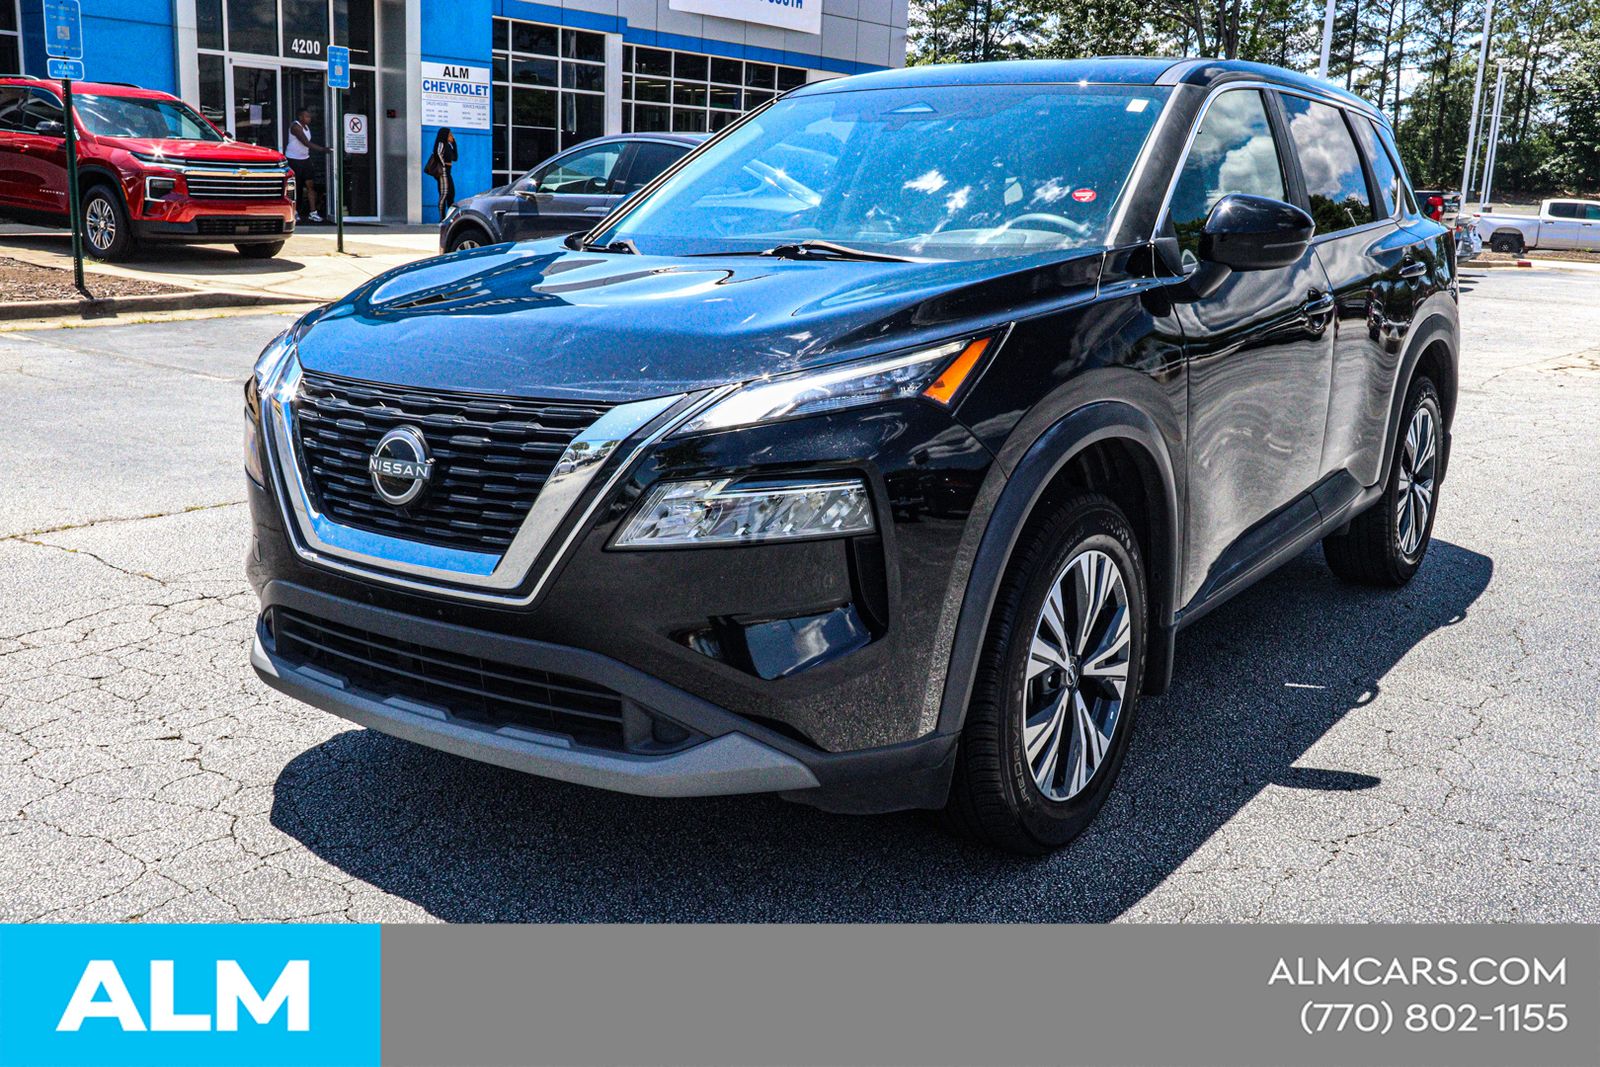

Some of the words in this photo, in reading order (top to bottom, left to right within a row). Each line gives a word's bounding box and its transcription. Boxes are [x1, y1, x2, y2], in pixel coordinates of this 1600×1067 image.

[291, 38, 321, 55] 4200
[443, 65, 469, 79] ALM
[423, 79, 488, 96] CHEVROLET
[369, 458, 428, 477] NISSAN
